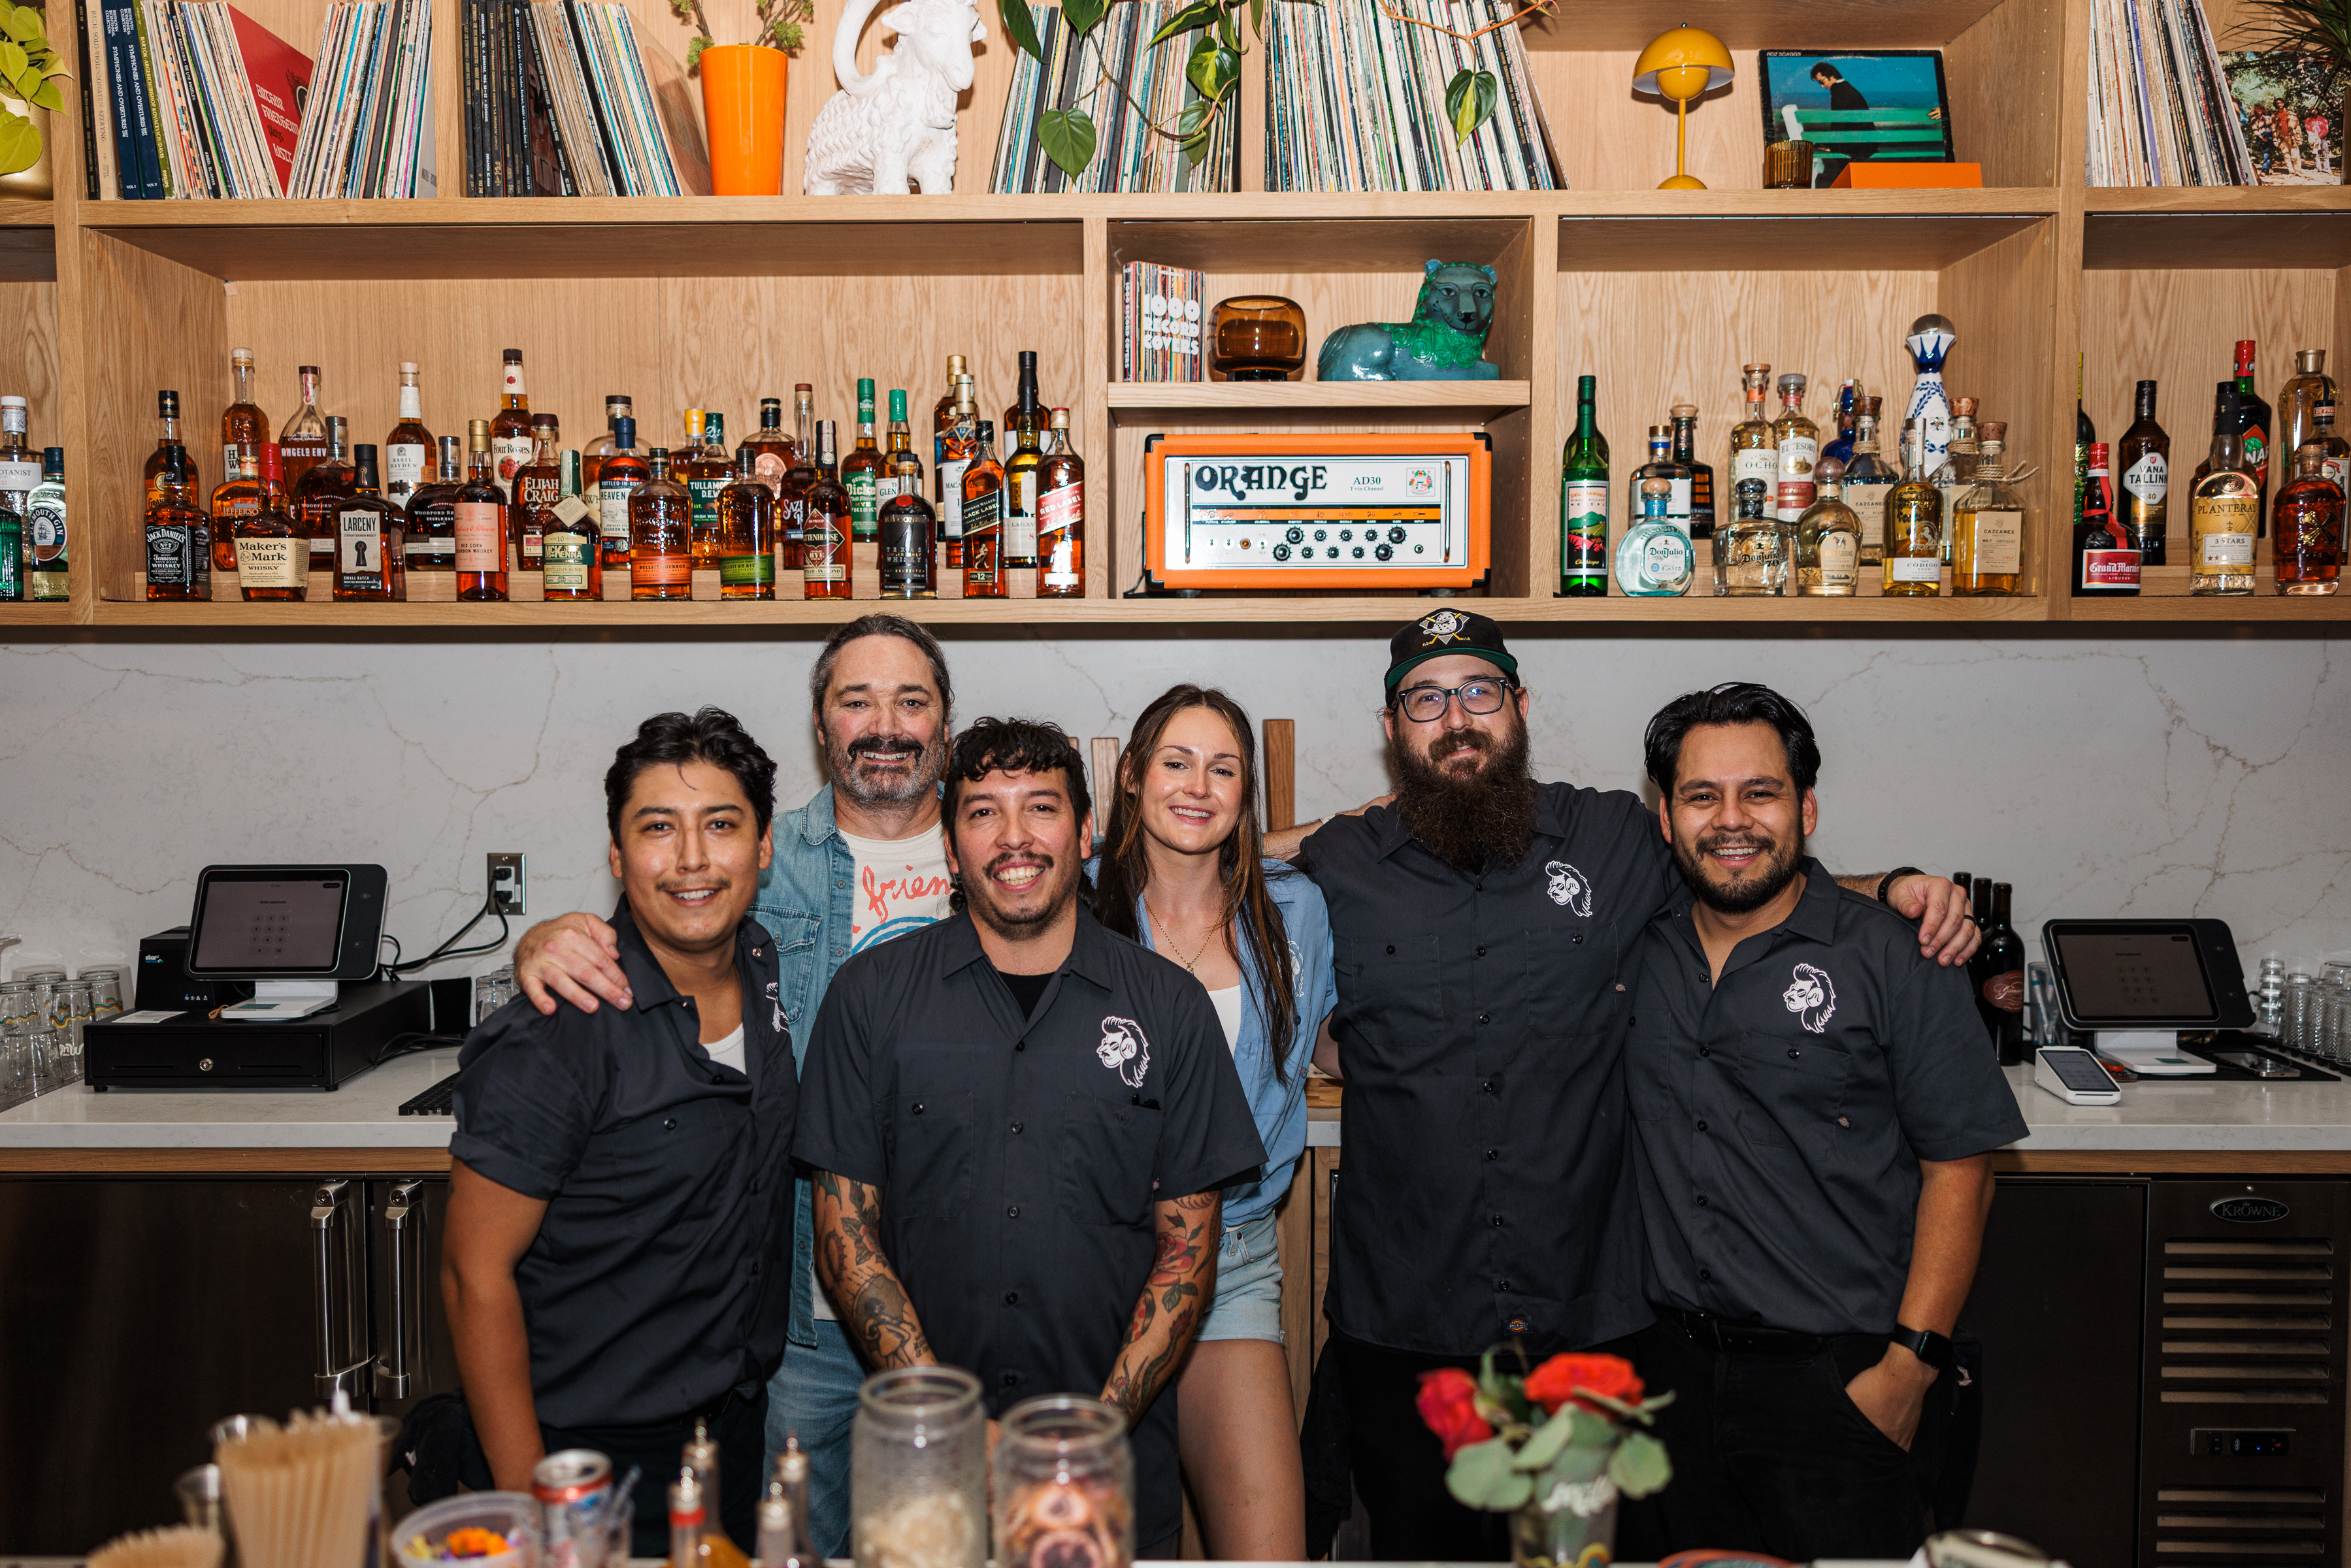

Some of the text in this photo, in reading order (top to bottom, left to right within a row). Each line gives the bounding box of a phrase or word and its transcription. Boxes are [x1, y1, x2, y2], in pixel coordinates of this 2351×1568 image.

[111, 46, 122, 82] SYMPHONIES
[118, 97, 127, 129] OVERTURES
[127, 44, 139, 80] SYMPHONIES
[135, 95, 146, 127] OVERTURES
[1513, 106, 1522, 126] PHILADELPHIA
[1518, 127, 1526, 144] ORCHESTRA
[151, 107, 165, 158] KOVACEVICH/DAVIS
[267, 124, 284, 142] plays
[1143, 293, 1200, 321] 1000
[1143, 316, 1200, 337] RECORD
[1143, 334, 1200, 355] COVERS
[312, 448, 327, 457] ENV
[493, 444, 530, 453] Four Roses
[1781, 442, 1816, 453] EL TESORO
[525, 477, 559, 491] ELIJAH
[1195, 465, 1327, 500] ORANGE
[524, 490, 559, 503] CRAIG
[600, 491, 626, 500] HEAVEN
[964, 504, 979, 514] JOHNNIE
[1040, 495, 1081, 515] RED LABEL
[2198, 504, 2256, 515] PLANTERAY
[54, 519, 64, 535] GIN
[344, 517, 376, 531] LARCENY
[147, 529, 186, 542] JACK DANIEL'S
[1837, 536, 1845, 547] 7
[1663, 547, 1683, 558] Julio
[2089, 563, 2139, 573] Grand Marnier
[863, 865, 952, 925] frien
[2222, 1204, 2280, 1216] KROWNE
